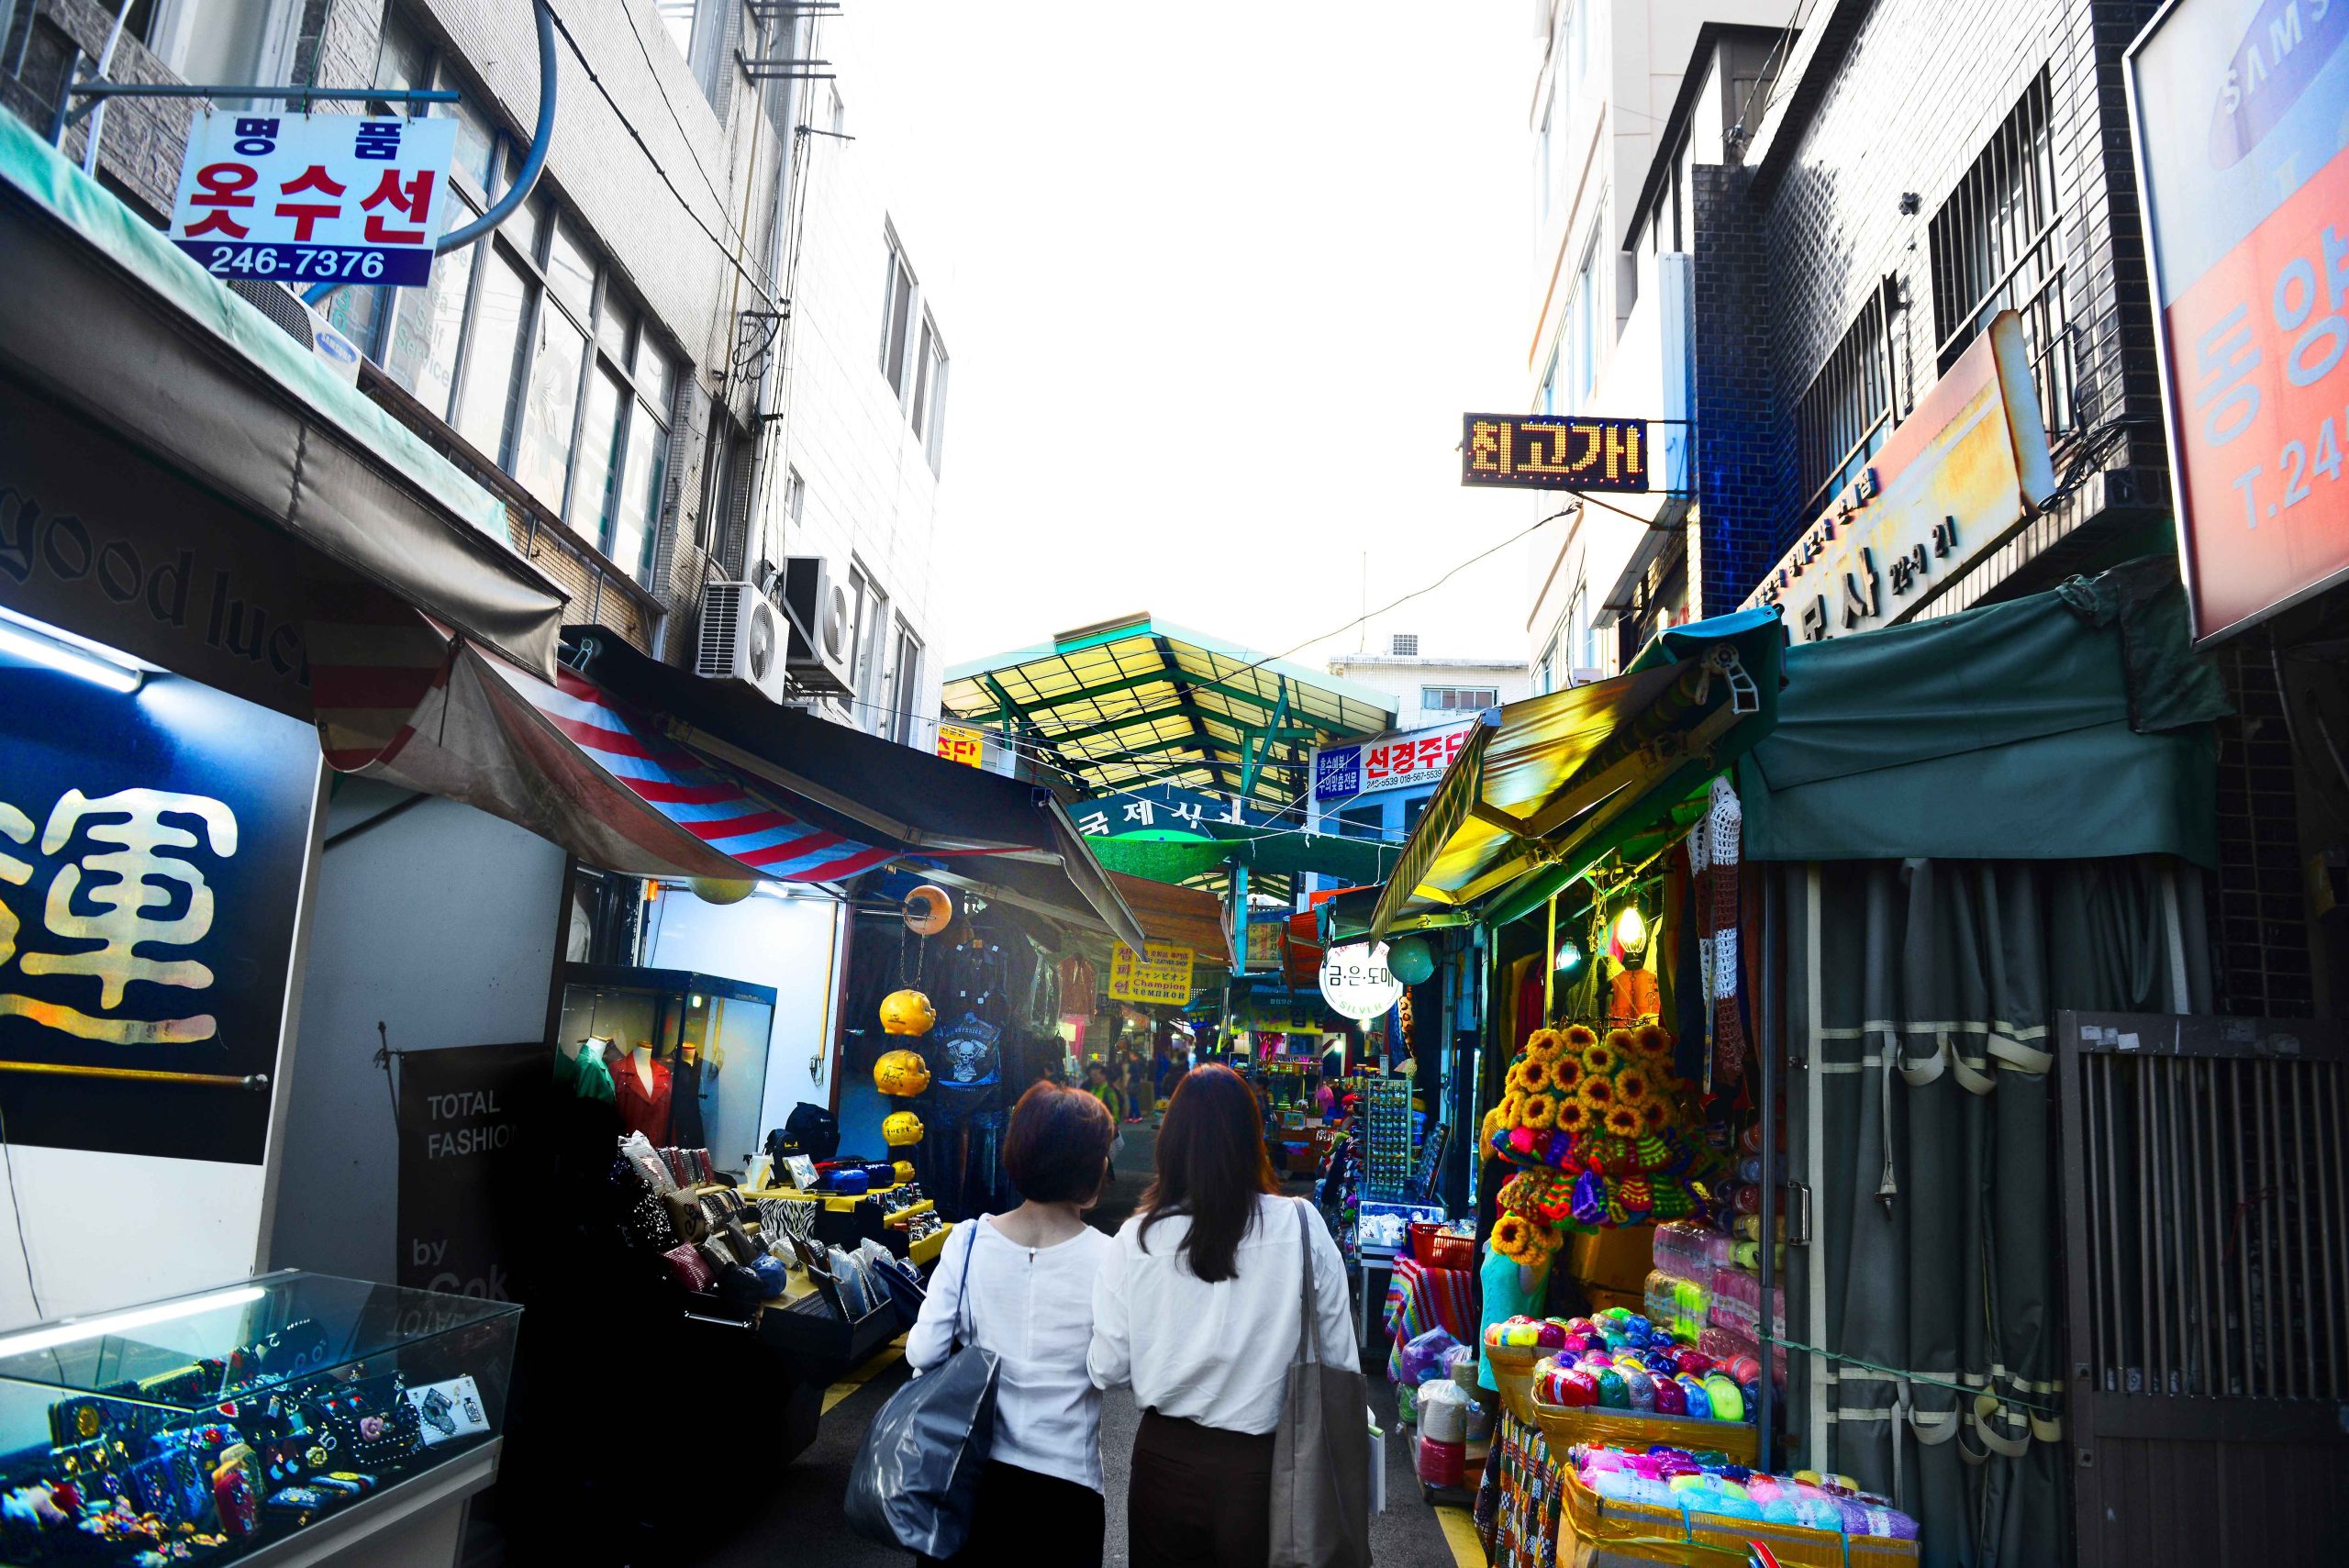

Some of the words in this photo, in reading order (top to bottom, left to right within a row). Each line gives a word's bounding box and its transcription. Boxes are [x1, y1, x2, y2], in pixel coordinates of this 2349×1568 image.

[184, 162, 436, 245] 옷수선
[208, 246, 384, 279] 246-7376
[416, 306, 445, 349] Self
[2194, 223, 2349, 449] 동양
[320, 332, 353, 364] SAMSUNG
[395, 323, 451, 388] Service
[2232, 405, 2349, 530] T.24
[0, 484, 196, 629] good
[206, 566, 311, 689] luc
[1399, 769, 1442, 784] 018-567-5539
[1133, 978, 1186, 991] Champion
[1339, 1000, 1383, 1015] SILVER
[427, 1089, 501, 1121] TOTAL
[412, 1237, 448, 1267] by
